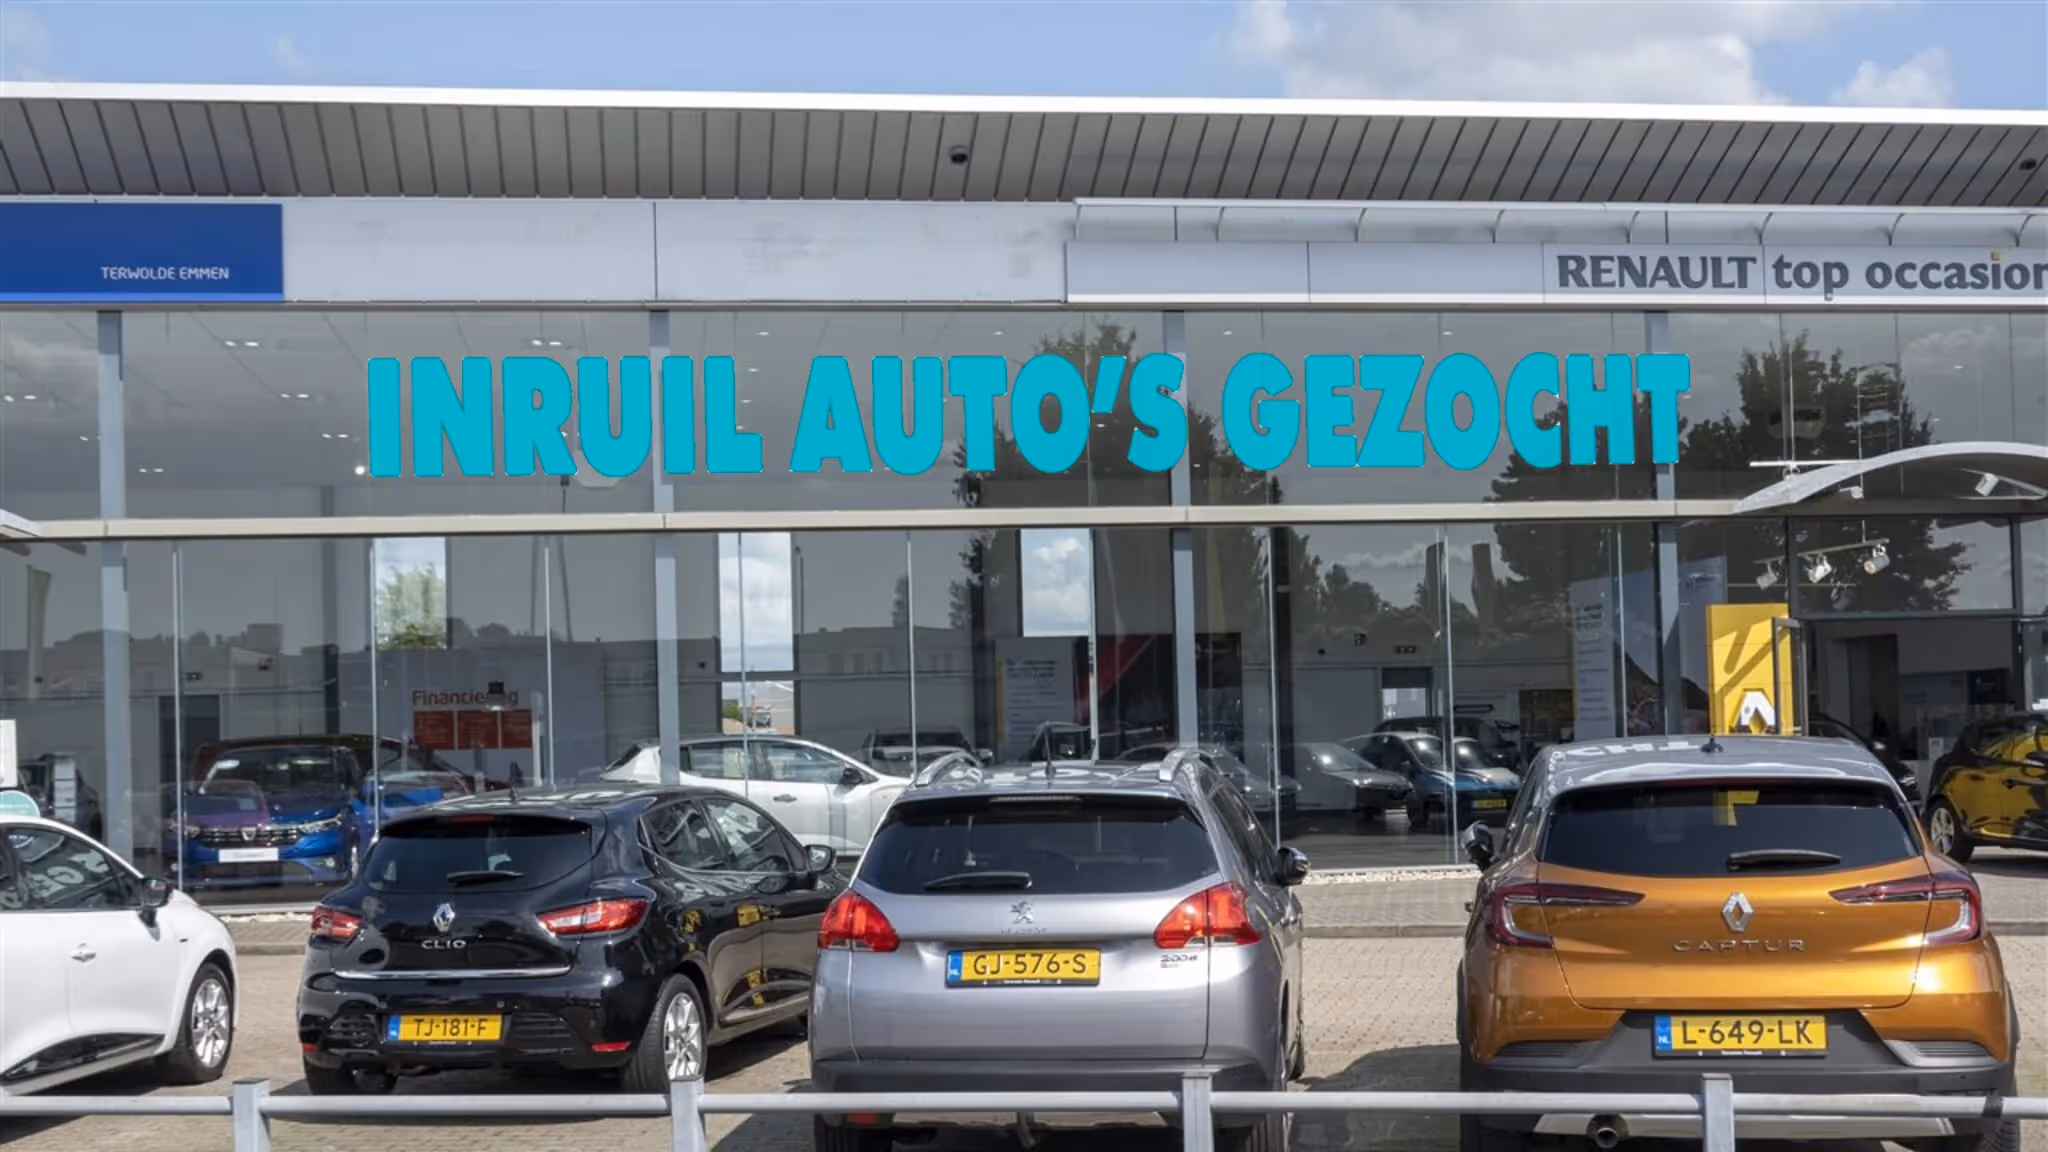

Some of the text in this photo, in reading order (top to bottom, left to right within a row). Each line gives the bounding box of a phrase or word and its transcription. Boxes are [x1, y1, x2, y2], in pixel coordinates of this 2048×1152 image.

[101, 266, 229, 280] TERWOLDE EMMEN
[1557, 255, 1757, 288] RENAULT
[1772, 254, 1849, 301] top
[368, 352, 1691, 478] INRUIL AUTO'S GEZOCHT
[412, 689, 519, 706] Financieg
[421, 939, 467, 950] CLIO
[1673, 939, 1806, 952] CAPTUR
[973, 953, 1087, 976] GJ-576-S
[414, 1018, 489, 1037] TJ-181-F
[1682, 1019, 1813, 1045] L-649-LK
[1658, 1035, 1670, 1045] NL
